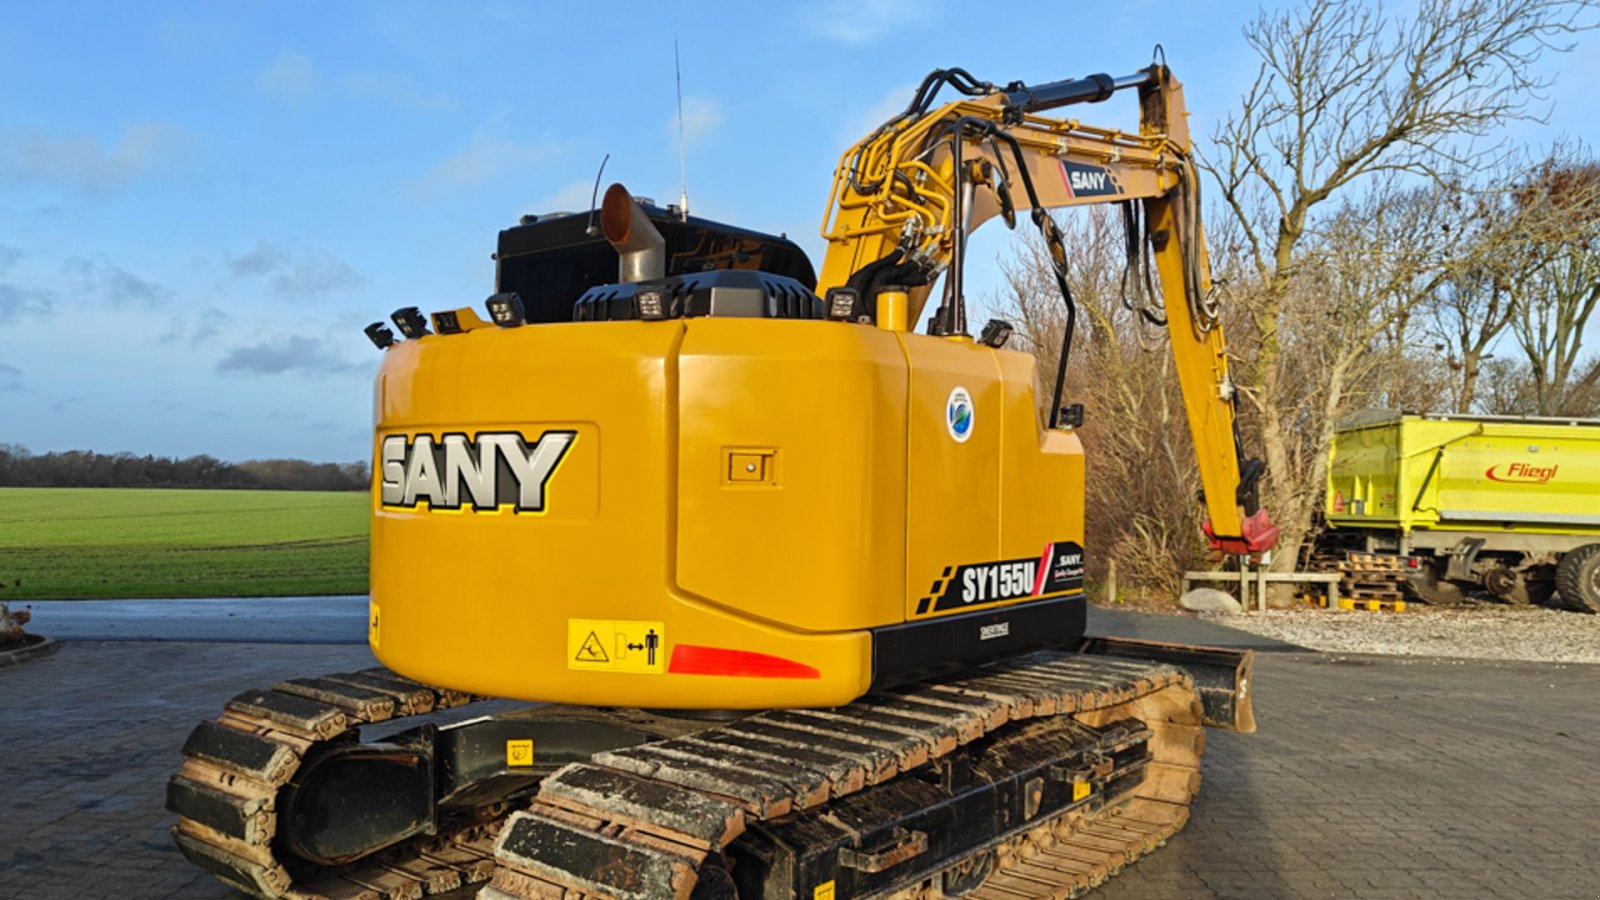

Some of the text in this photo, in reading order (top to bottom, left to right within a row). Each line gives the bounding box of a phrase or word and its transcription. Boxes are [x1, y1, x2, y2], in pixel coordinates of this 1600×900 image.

[1071, 171, 1106, 190] SANY
[382, 432, 574, 511] SANY
[1507, 463, 1559, 484] Fliegl
[962, 561, 1035, 603] SY155U
